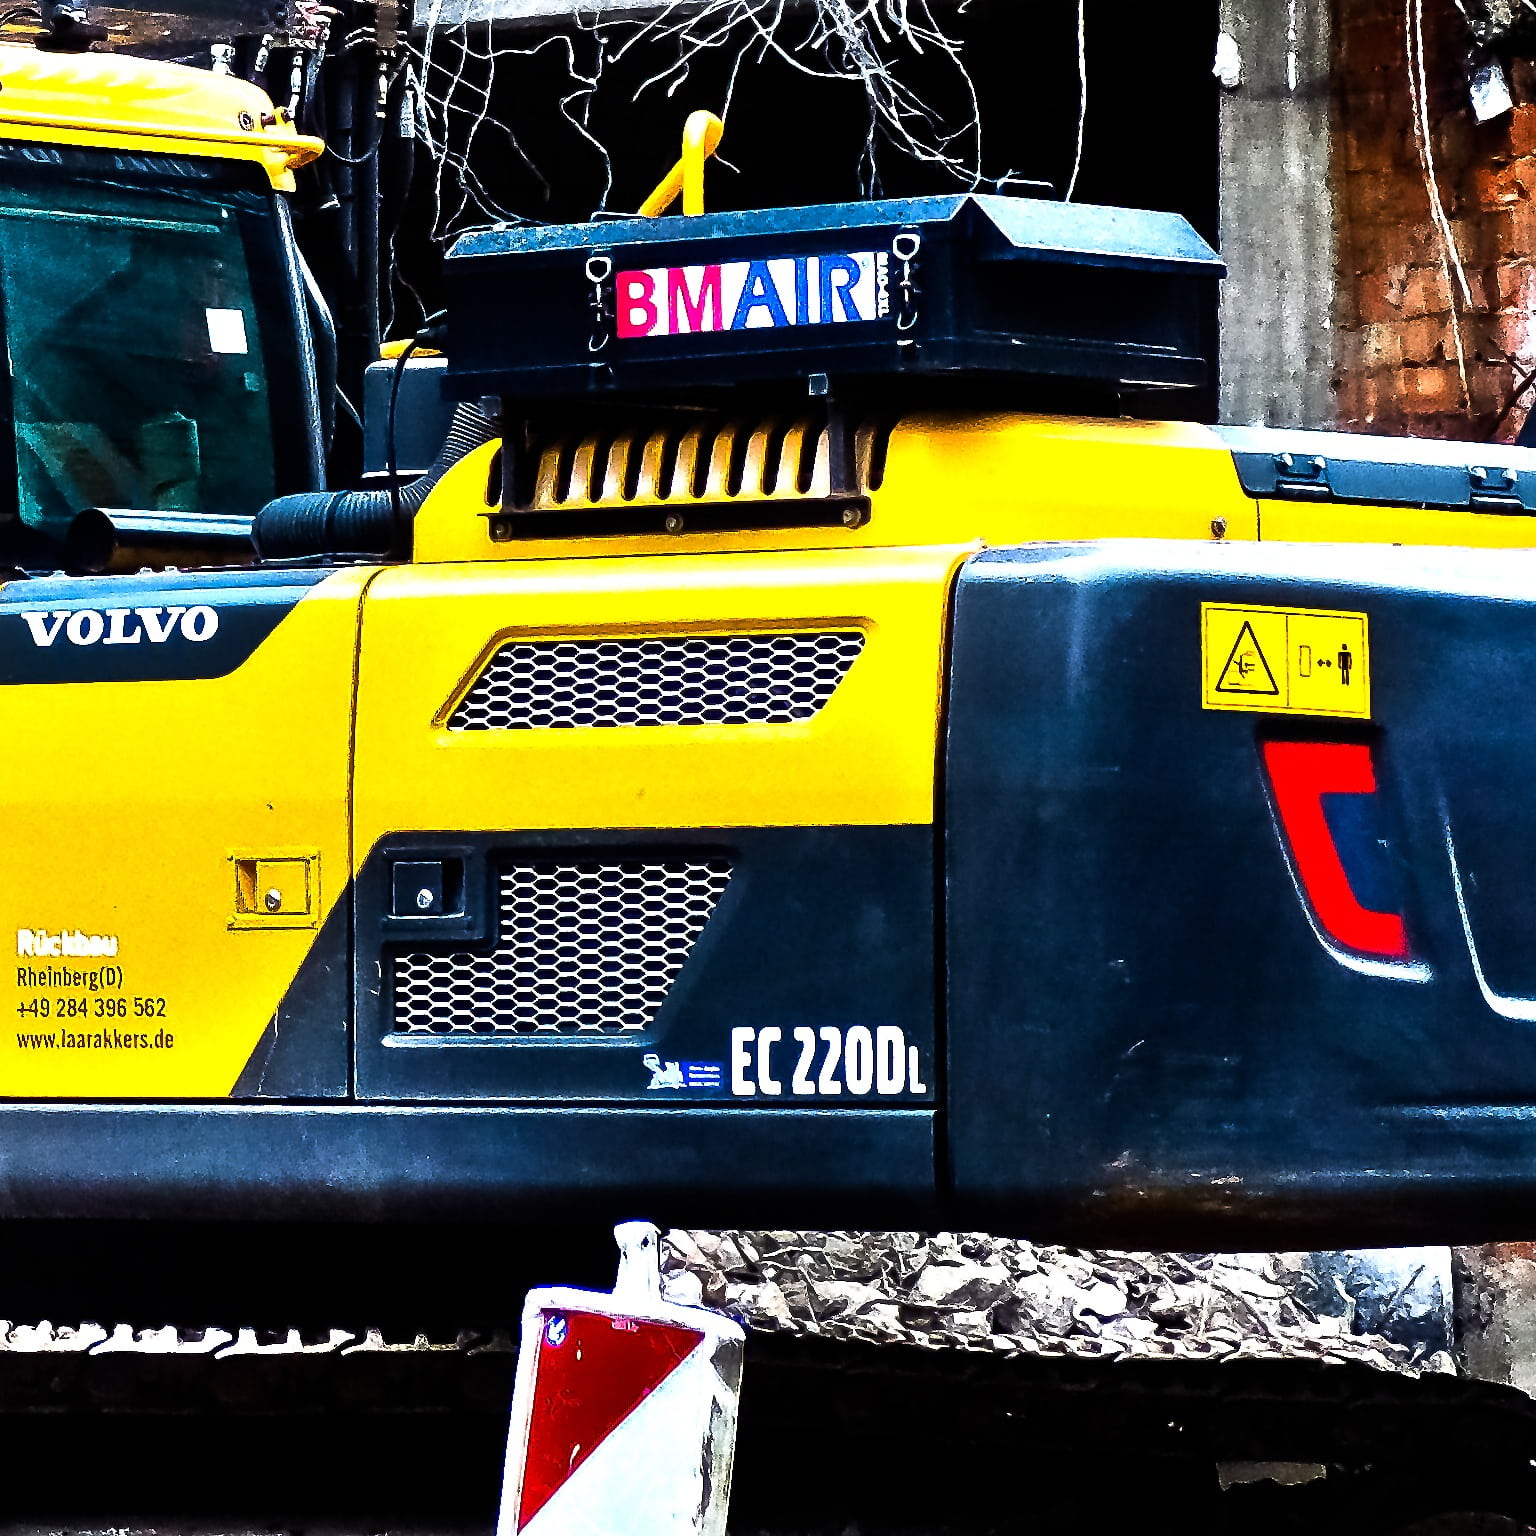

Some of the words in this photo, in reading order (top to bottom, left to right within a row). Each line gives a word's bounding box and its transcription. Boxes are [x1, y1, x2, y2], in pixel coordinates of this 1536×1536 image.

[615, 254, 861, 339] BMAIR
[21, 605, 219, 647] VOLVO
[17, 966, 123, 991] Rheinberg(D)
[17, 998, 50, 1017] +49
[57, 998, 88, 1018] 284
[95, 998, 127, 1017] 396
[134, 997, 166, 1017] 562
[17, 1028, 174, 1049] www.laarakkers.de
[732, 1027, 781, 1095] EC
